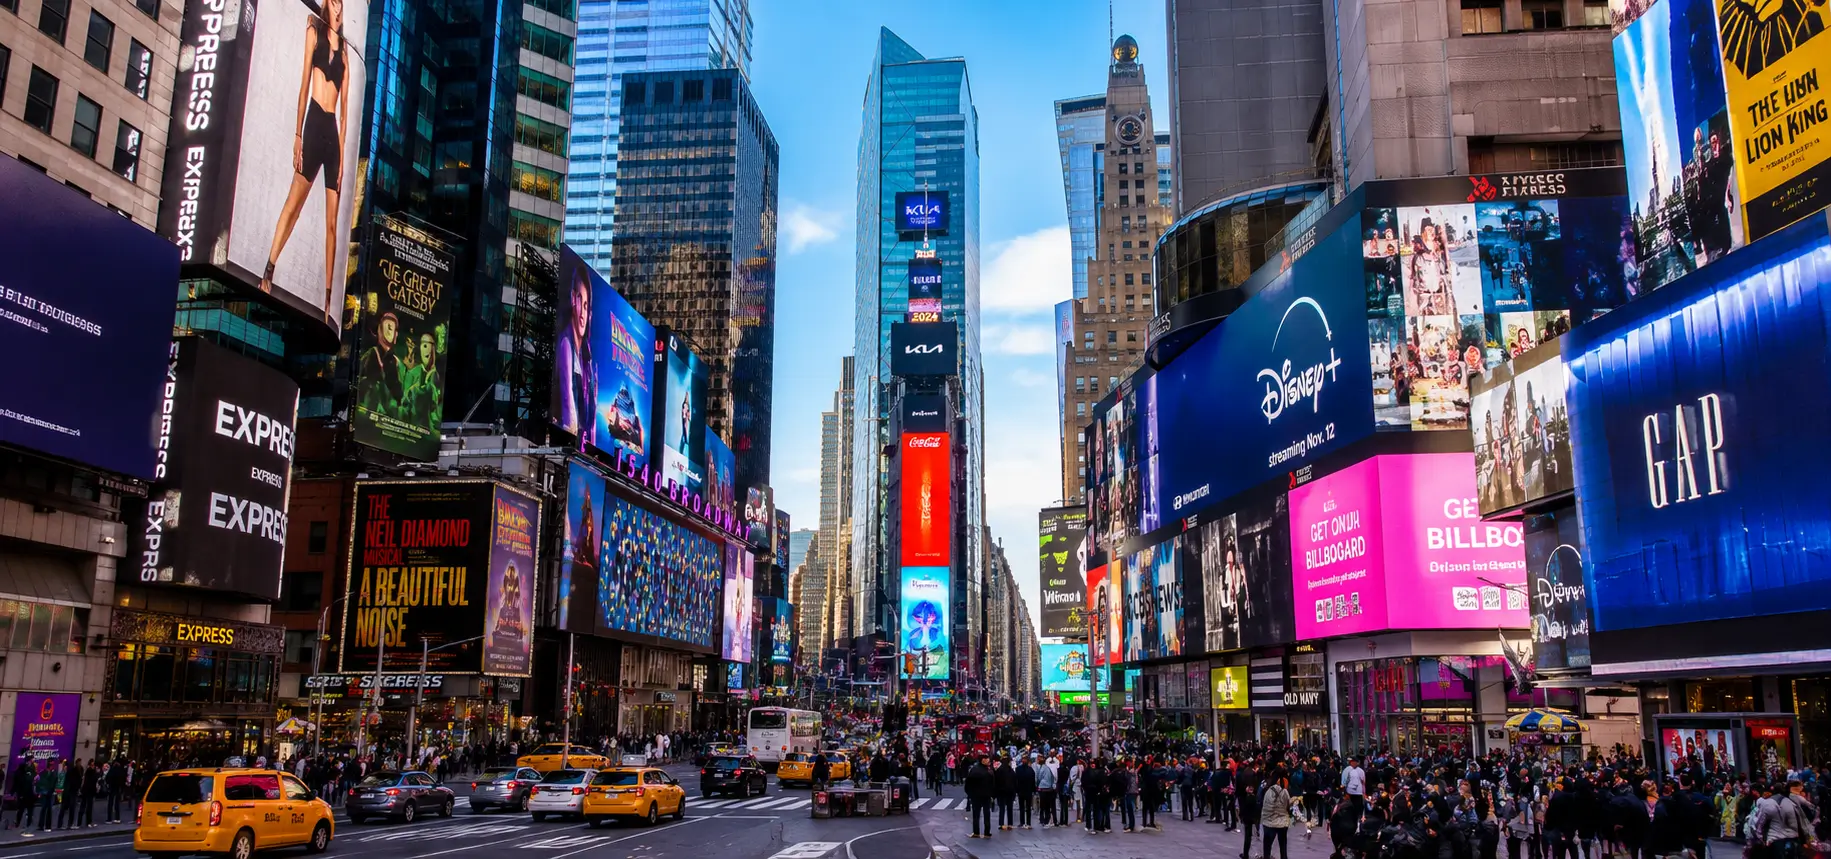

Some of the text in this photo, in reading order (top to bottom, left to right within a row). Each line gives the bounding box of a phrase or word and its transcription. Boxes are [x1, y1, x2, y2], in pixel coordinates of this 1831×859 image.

[1748, 90, 1781, 127] THE
[1745, 123, 1784, 165] LION
[1786, 99, 1828, 145] KING
[388, 280, 436, 315] GATSBY
[403, 269, 443, 300] GREAT
[1268, 422, 1335, 468] streaming Nov. 12
[1643, 392, 1728, 509] GAP
[617, 447, 663, 493] 1540
[368, 493, 393, 520] THE
[364, 520, 397, 548] NEIL
[401, 519, 470, 548] DIAMOND
[1310, 519, 1329, 543] GET
[1427, 526, 1525, 549] BILLBO
[363, 548, 405, 567] MUSICAL
[358, 566, 469, 607] A BEAUTIFUL
[177, 623, 234, 645] EXPRESS
[355, 606, 409, 647] NOISE
[1284, 692, 1319, 706] OLD NAVY
